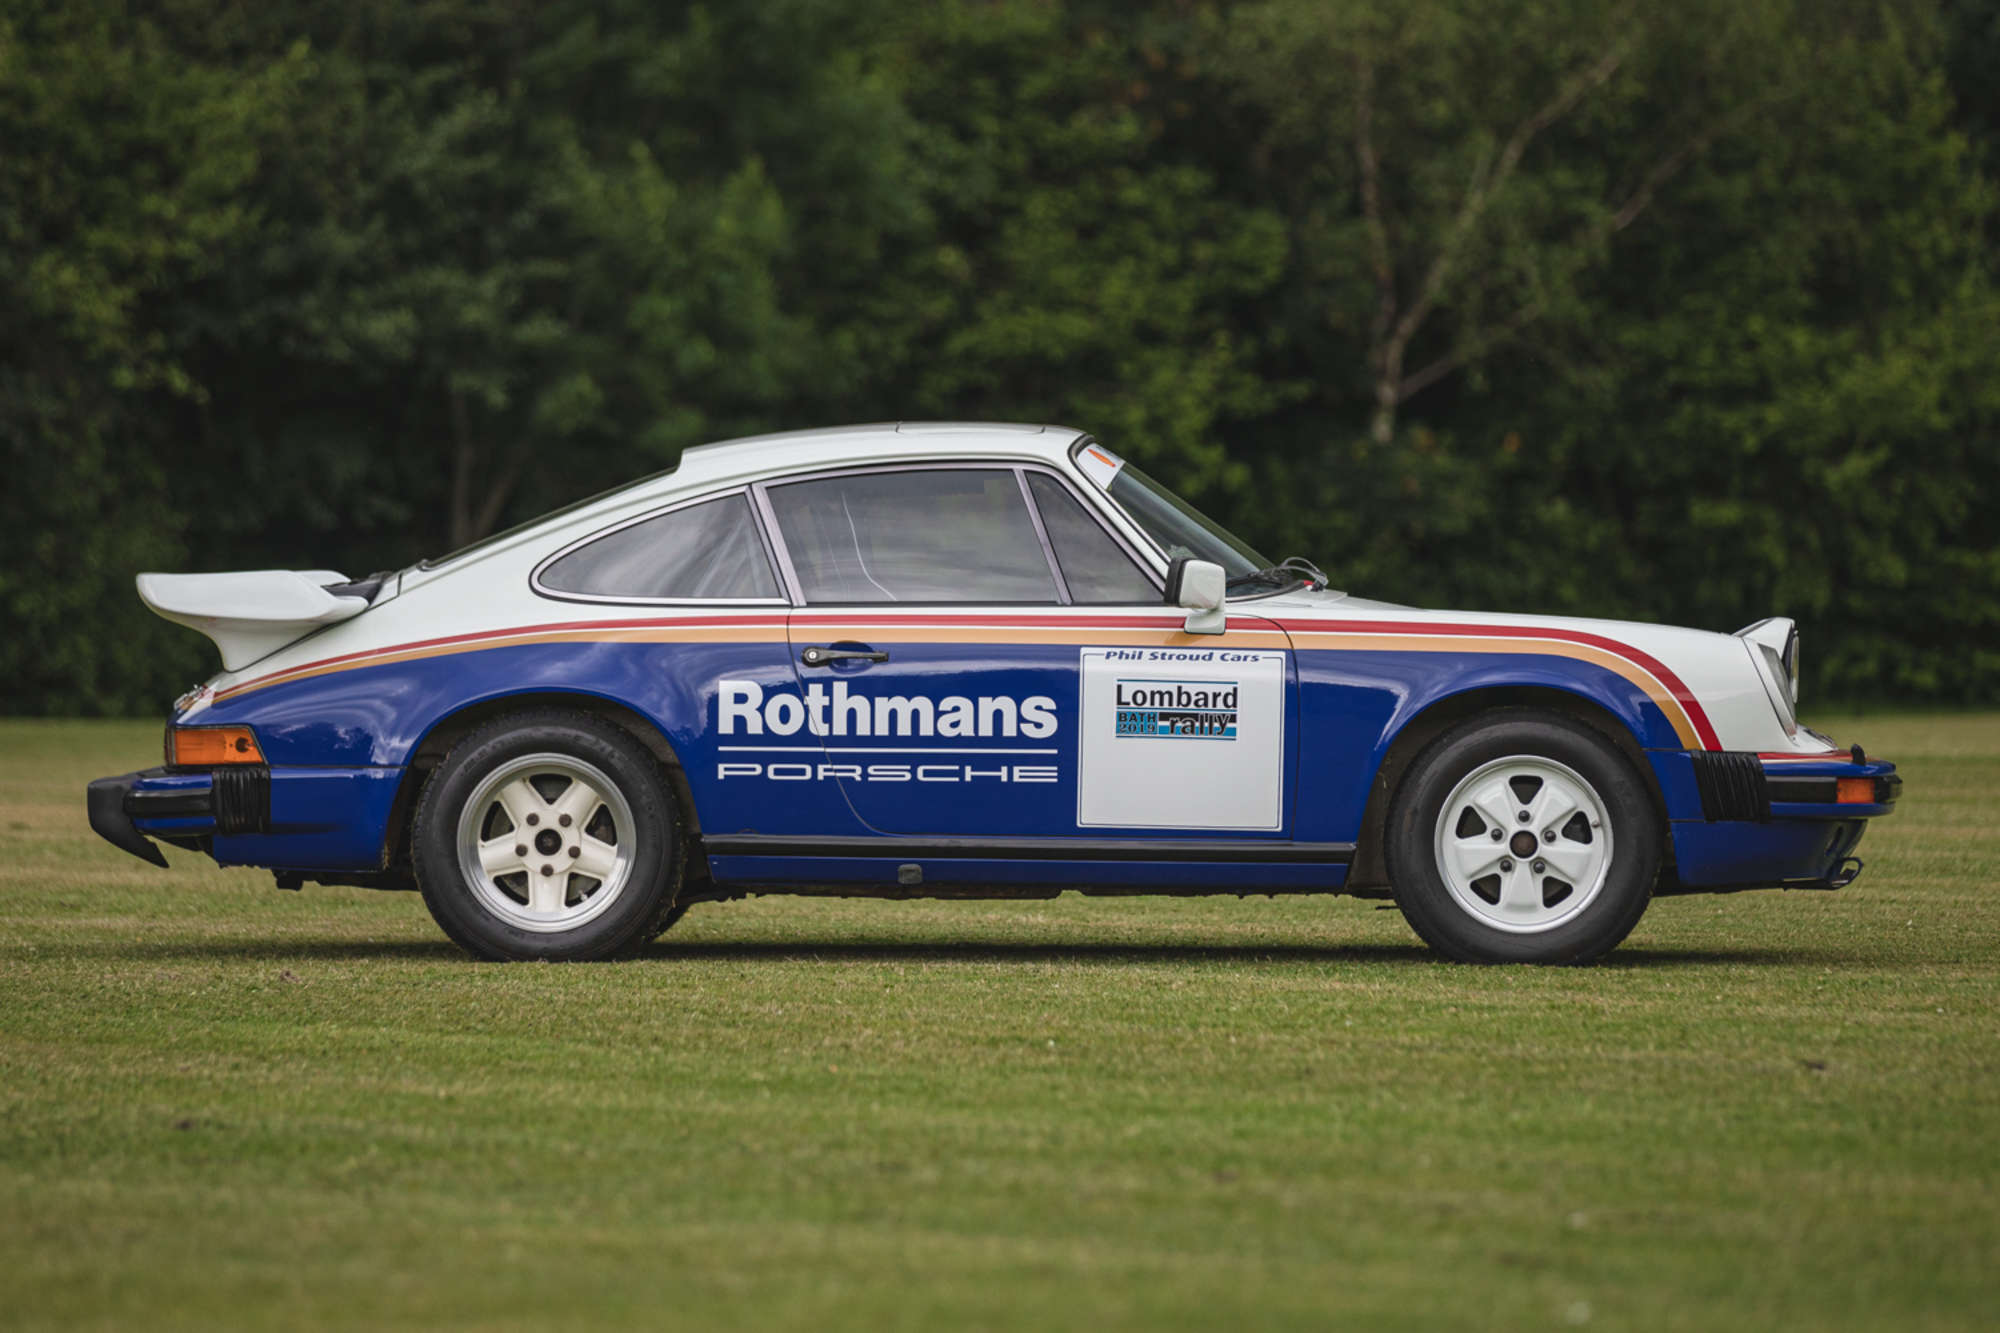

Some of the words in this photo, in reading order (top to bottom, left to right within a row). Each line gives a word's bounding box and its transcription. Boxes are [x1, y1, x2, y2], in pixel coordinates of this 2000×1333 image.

[1105, 650, 1144, 660] Phil
[1149, 651, 1214, 662] Stroud
[1219, 652, 1260, 662] Cars
[1116, 683, 1238, 709] Lombard
[718, 680, 1058, 739] Rothmans
[1119, 712, 1157, 723] BATH
[1119, 723, 1156, 734] 2019
[1169, 712, 1231, 736] rally
[718, 763, 1058, 782] PORSCHE
